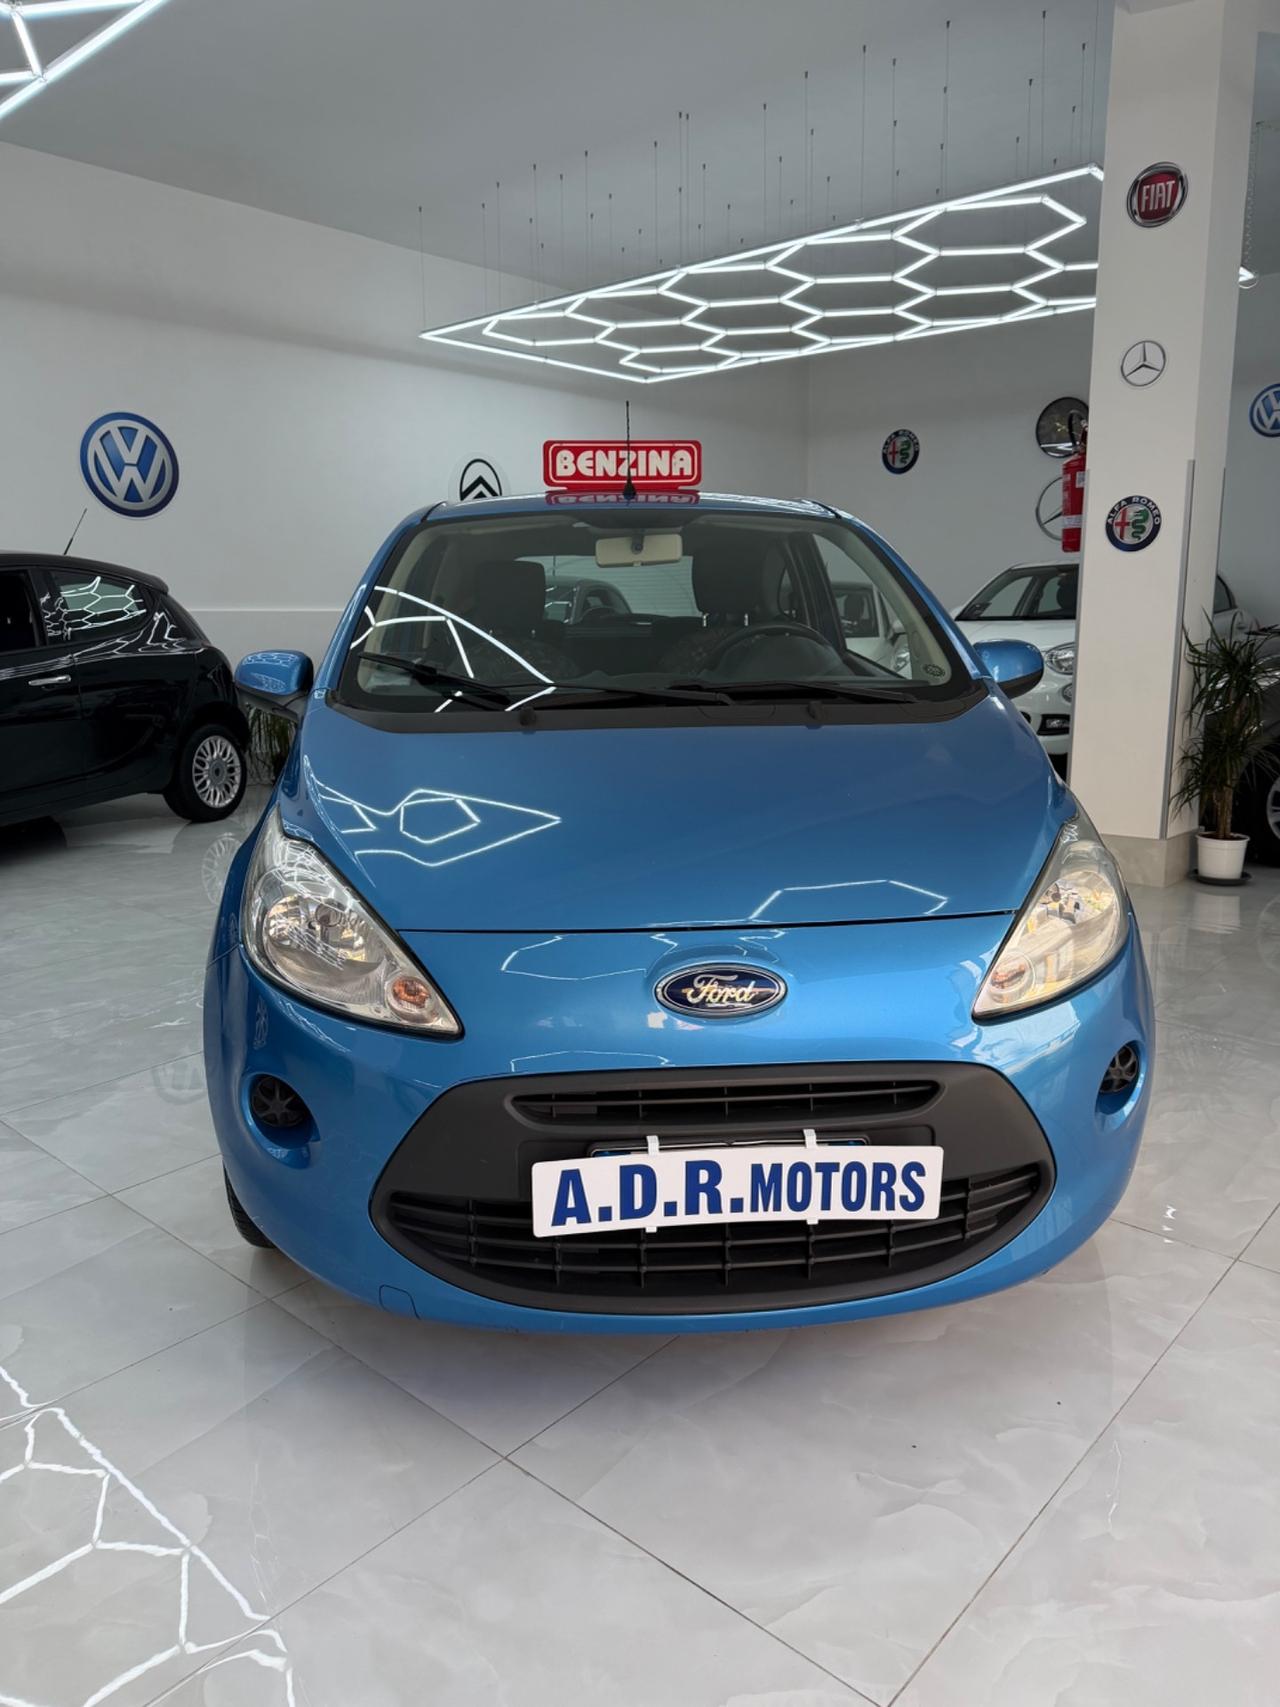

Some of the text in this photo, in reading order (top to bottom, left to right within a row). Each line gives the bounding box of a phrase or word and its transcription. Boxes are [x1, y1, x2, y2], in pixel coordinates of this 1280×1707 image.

[1141, 180, 1176, 212] FIAT
[556, 449, 693, 477] BENZINA
[1107, 500, 1128, 525] ALFA
[1131, 496, 1161, 525] ROMEO
[682, 974, 760, 1007] Ford
